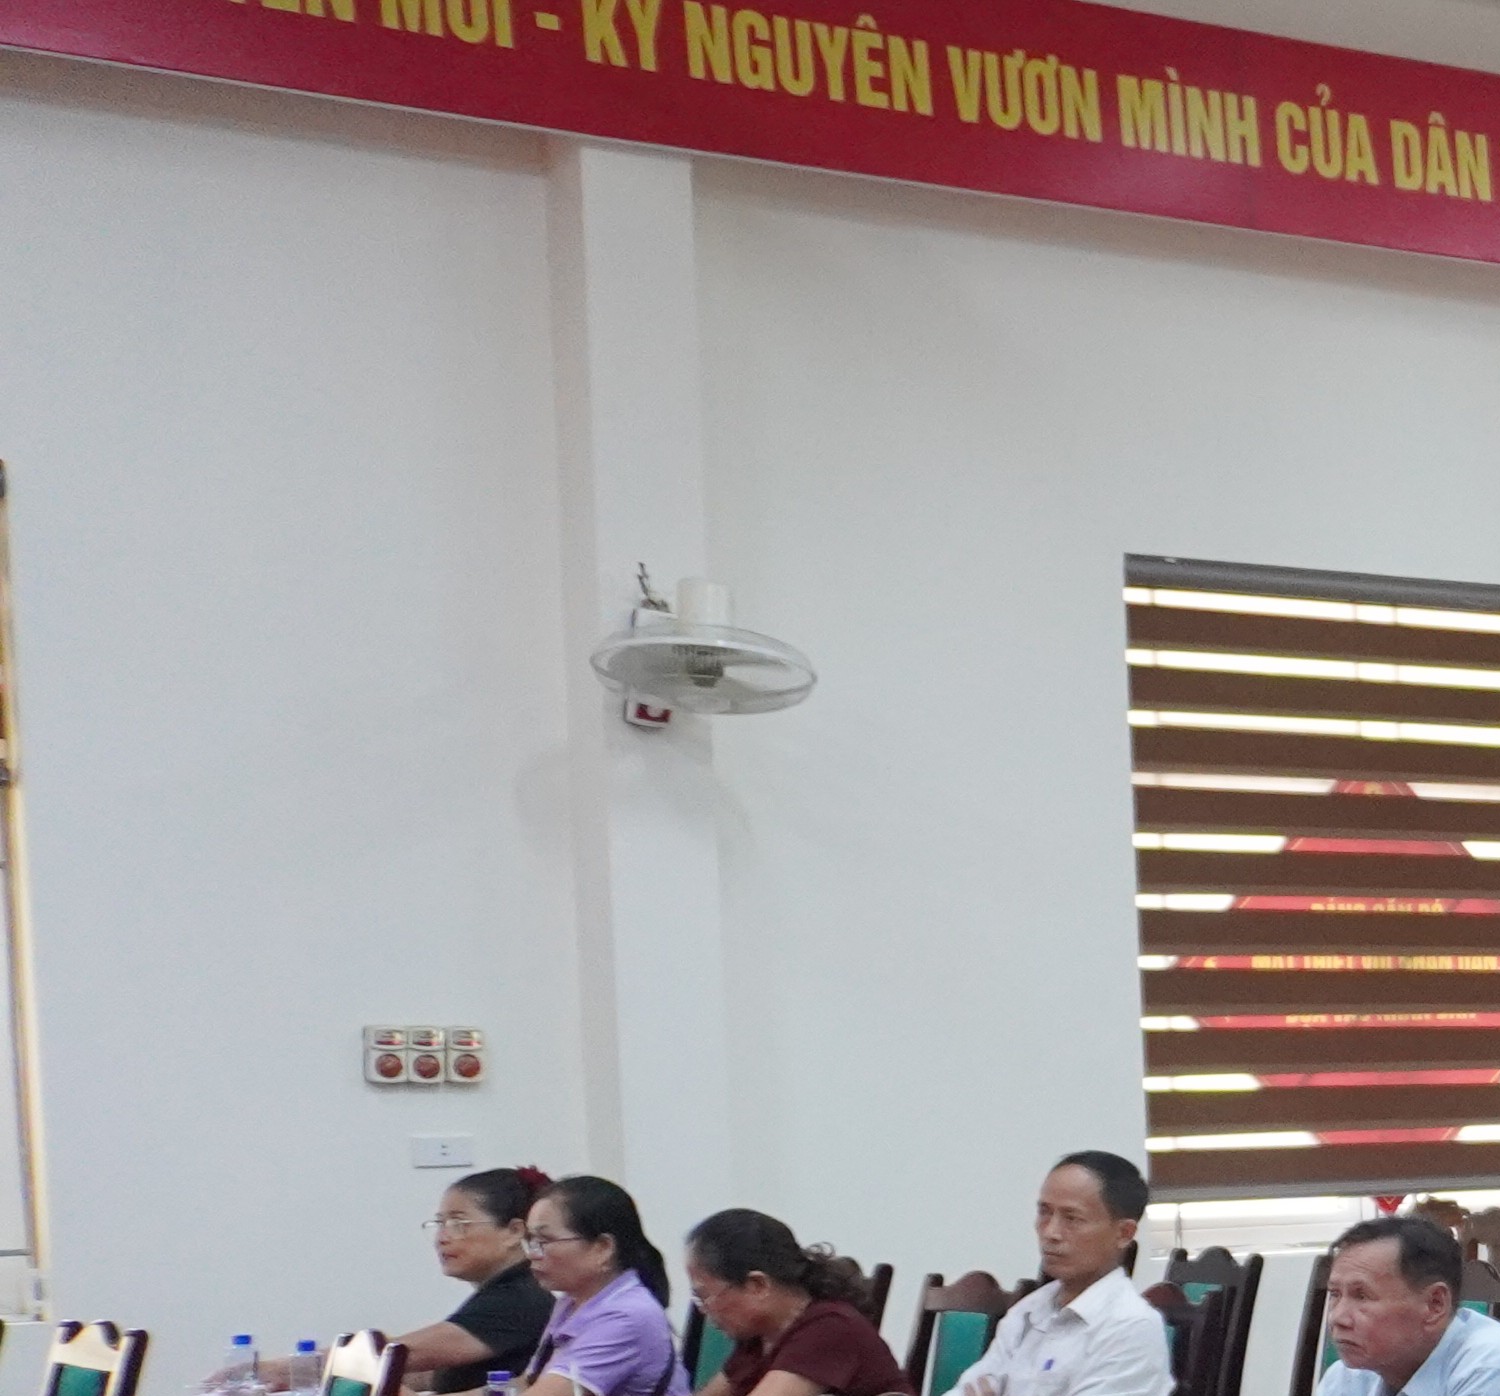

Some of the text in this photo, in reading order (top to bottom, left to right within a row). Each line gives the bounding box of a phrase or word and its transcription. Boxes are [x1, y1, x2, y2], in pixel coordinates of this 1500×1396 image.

[683, 1, 933, 117] NGUYÊN
[946, 46, 1102, 143] VƯƠN
[1116, 66, 1262, 168] MÌNH
[1275, 82, 1379, 185] CỦA
[1389, 111, 1492, 202] DÂN
